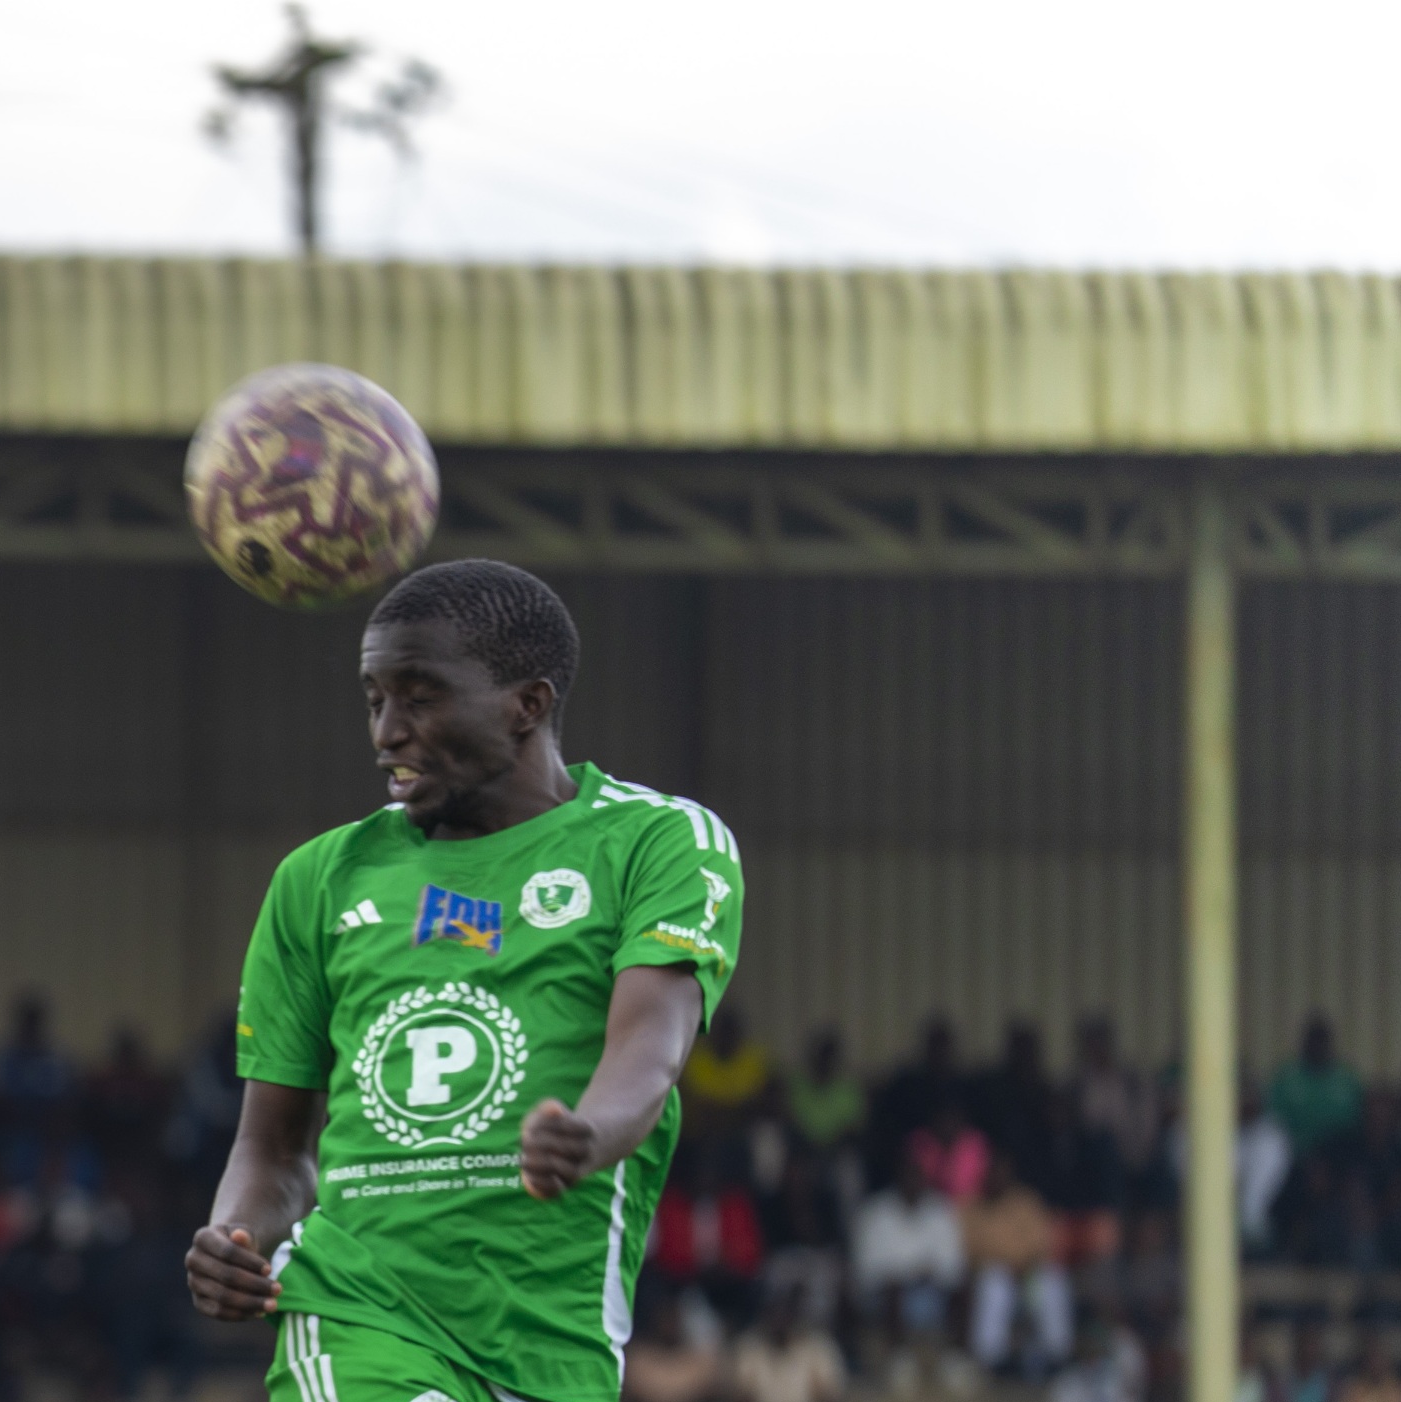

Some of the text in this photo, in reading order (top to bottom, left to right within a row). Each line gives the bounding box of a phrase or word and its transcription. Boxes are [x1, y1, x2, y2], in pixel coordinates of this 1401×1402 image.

[411, 883, 502, 957] FDH
[405, 1025, 477, 1107] P
[369, 1156, 460, 1176] INSURANCE
[462, 1153, 523, 1169] COMPA
